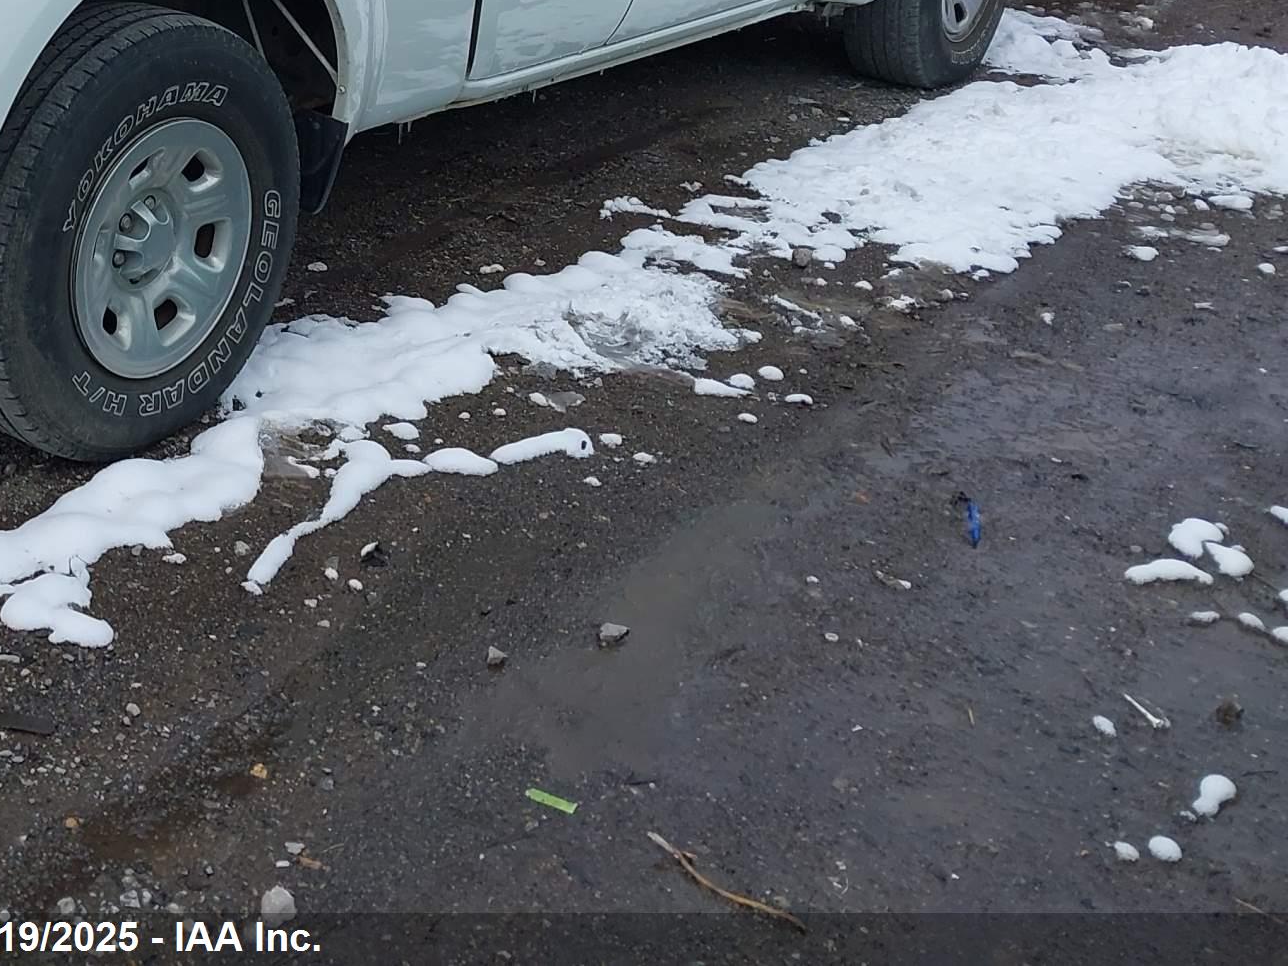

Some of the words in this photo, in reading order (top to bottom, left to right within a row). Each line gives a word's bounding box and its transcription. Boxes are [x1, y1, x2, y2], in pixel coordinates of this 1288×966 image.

[62, 82, 229, 233] YOKOHAMA
[138, 189, 282, 418] GEOLANDAR
[71, 371, 128, 417] H/T
